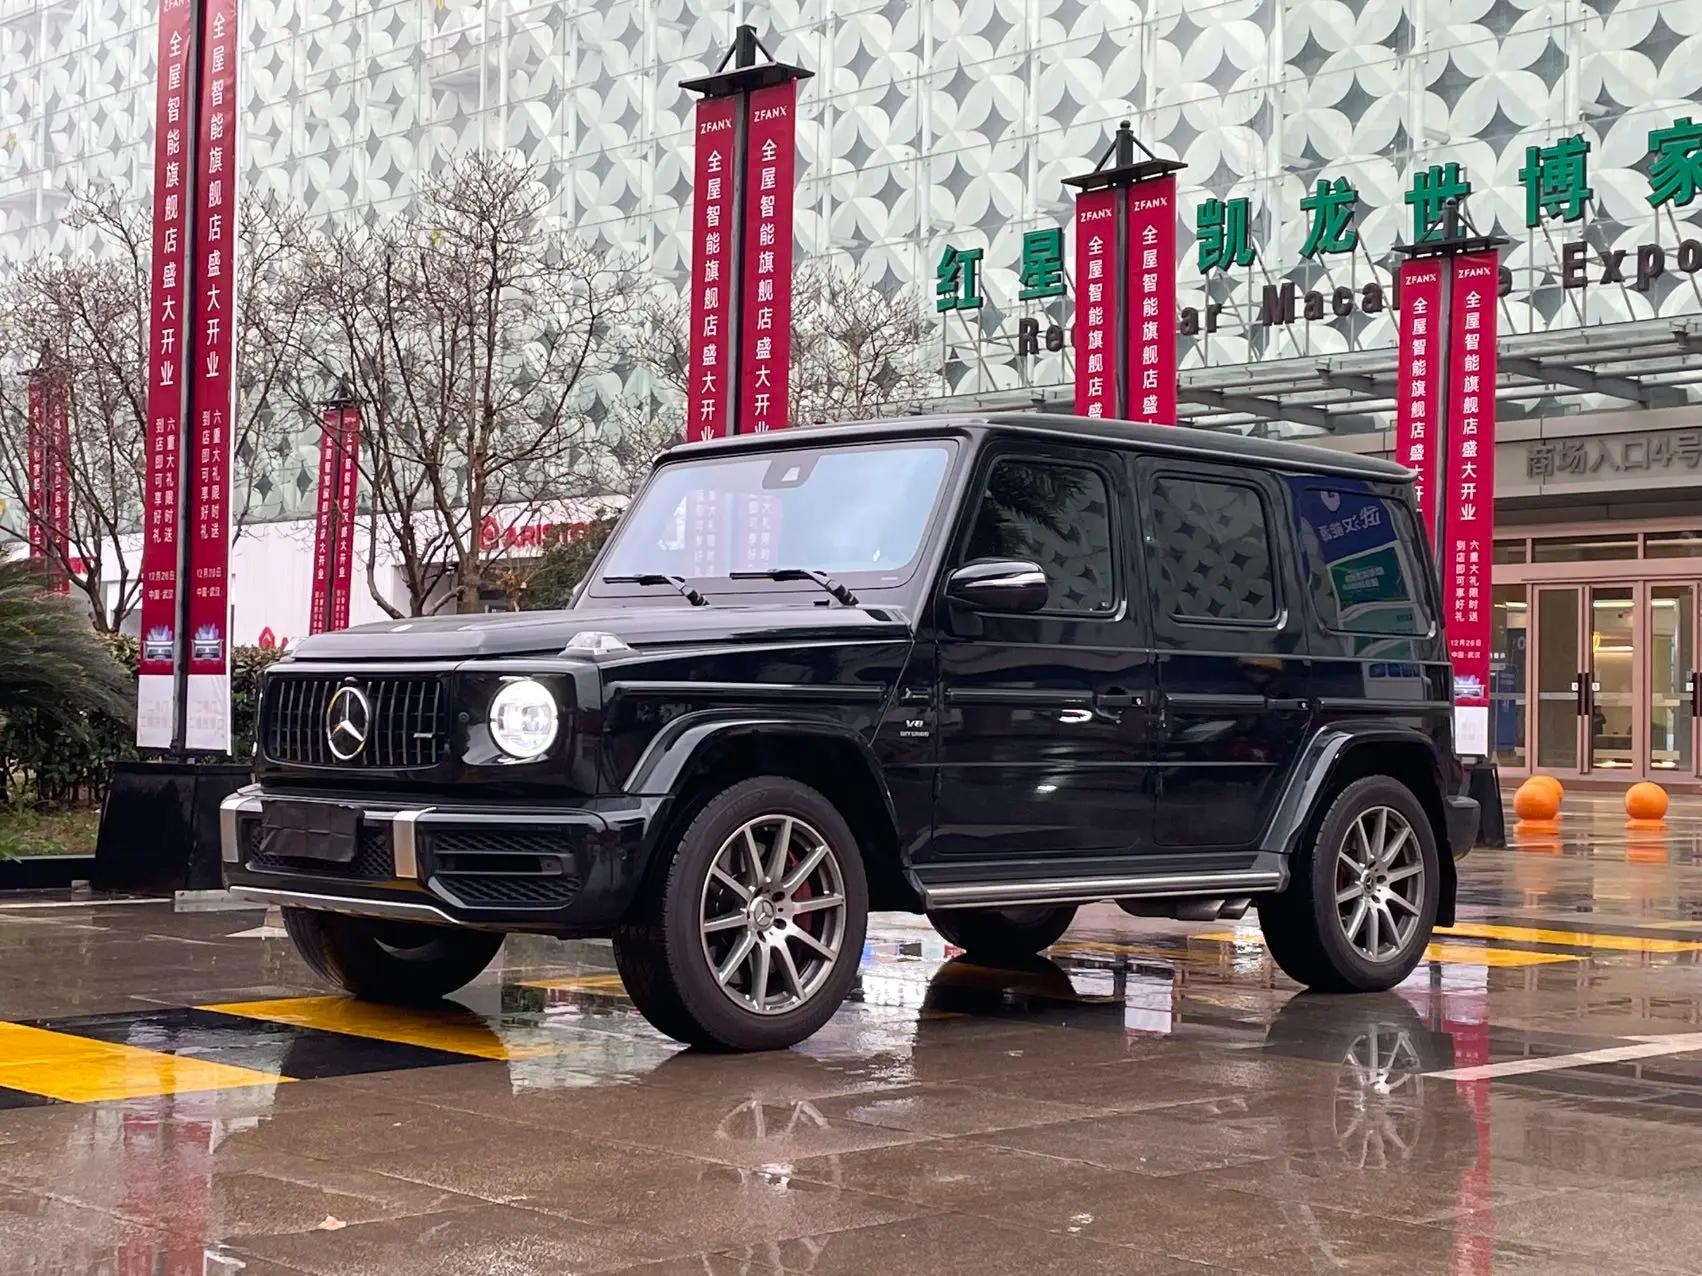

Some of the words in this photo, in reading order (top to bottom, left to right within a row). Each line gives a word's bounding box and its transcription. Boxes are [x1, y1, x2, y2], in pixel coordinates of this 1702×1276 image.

[700, 118, 732, 134] ZFANX
[754, 105, 787, 122] ZFANX
[160, 30, 183, 386] 全屋智能旗舰店盛大开业
[205, 11, 226, 379] 全屋智能旗舰店盛大开业
[1080, 207, 1112, 224] ZFANX
[1134, 196, 1168, 211] ZFANX
[1405, 273, 1437, 286] ZFANX
[1458, 266, 1491, 279] ZFANX
[1563, 238, 1702, 291] Expo
[1460, 290, 1482, 521] 全屋智能旗舰店盛大开业
[152, 417, 165, 543] 到店即可享好礼
[163, 417, 176, 543] 六重大礼限时送
[200, 410, 211, 540] 到店即可享好礼
[210, 409, 223, 538] 六重大礼限时送
[1526, 431, 1702, 479] 商场入口4号
